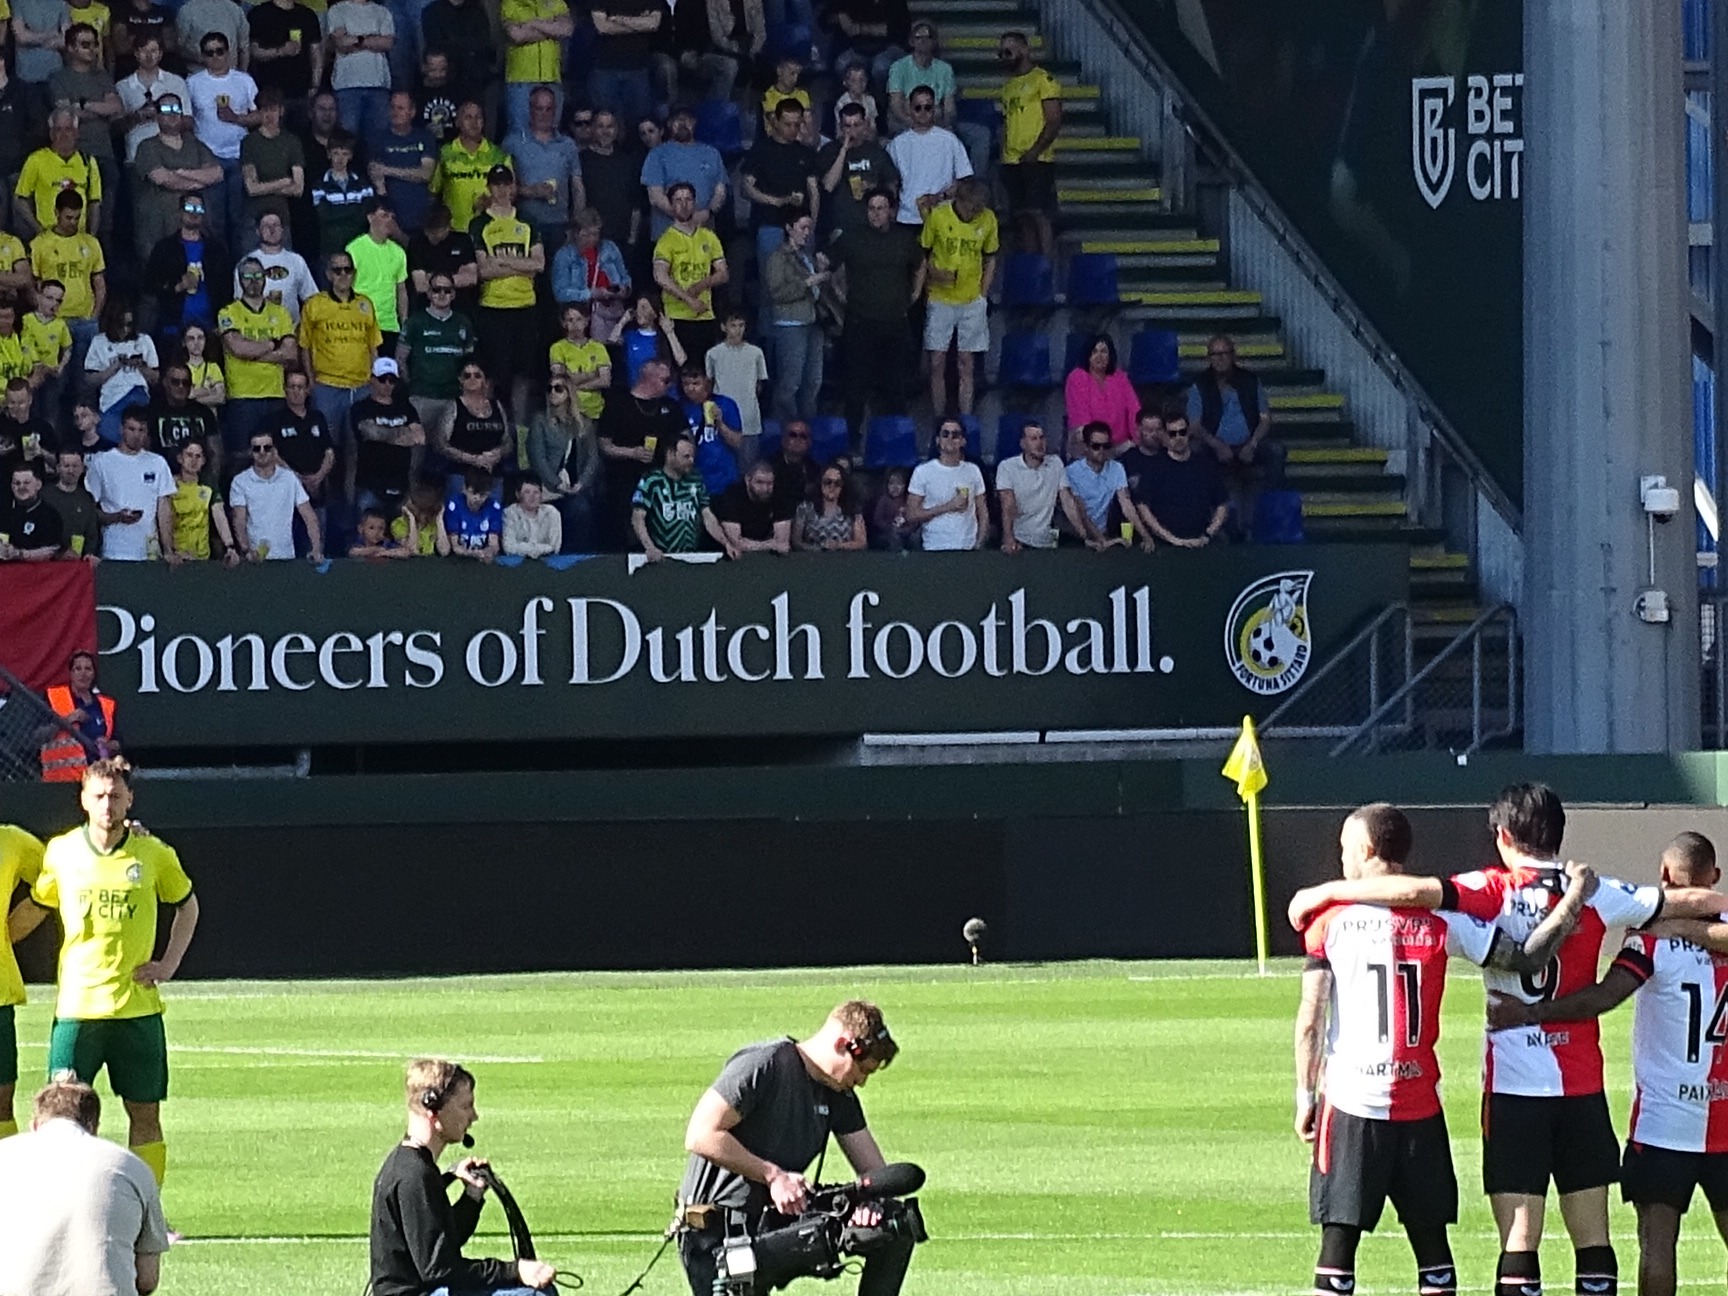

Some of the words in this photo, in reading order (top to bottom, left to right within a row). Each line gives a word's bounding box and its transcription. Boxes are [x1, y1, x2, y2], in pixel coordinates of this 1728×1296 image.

[1467, 74, 1524, 135] BE
[1467, 139, 1524, 201] CIT
[465, 595, 554, 688] of
[568, 590, 826, 687] Dutch
[845, 584, 1175, 683] football.
[1367, 962, 1423, 1048] 11
